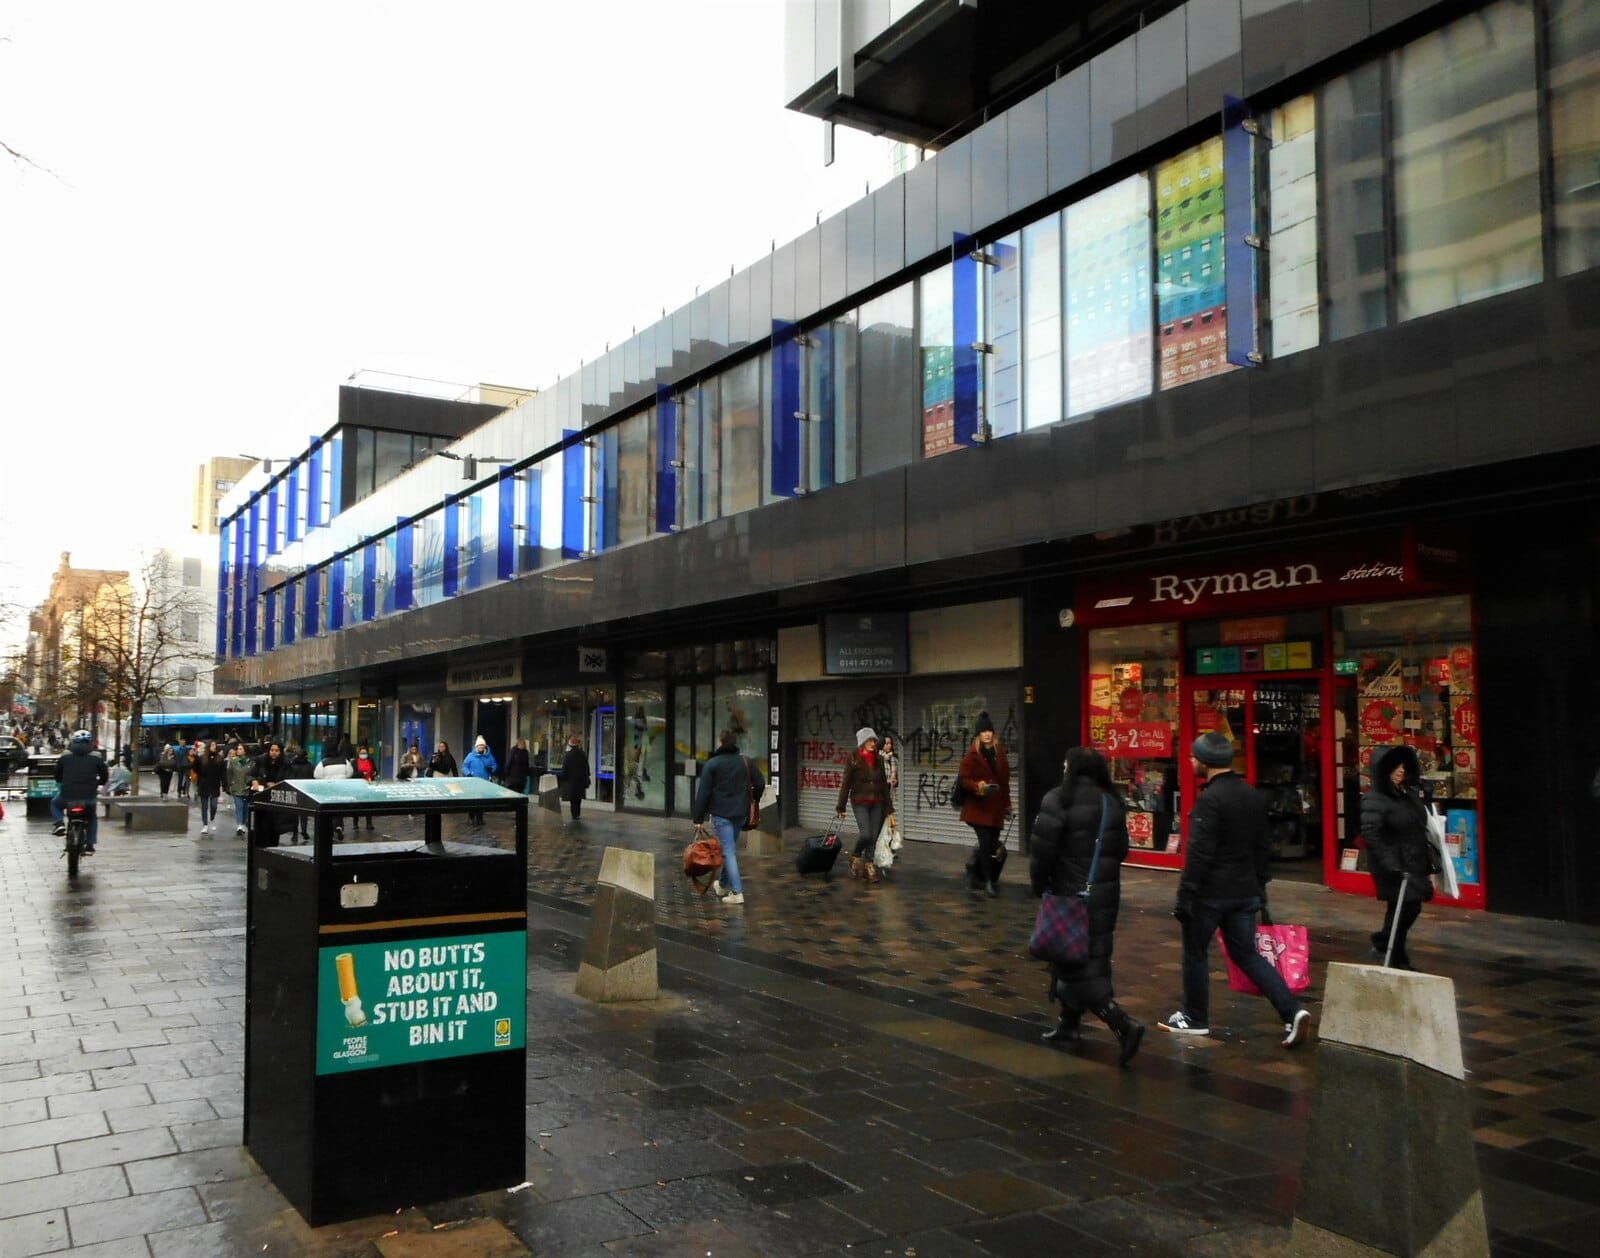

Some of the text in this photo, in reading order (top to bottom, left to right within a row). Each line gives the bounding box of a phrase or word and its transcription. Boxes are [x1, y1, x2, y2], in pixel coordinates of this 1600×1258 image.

[1200, 335, 1217, 345] 10%
[1150, 562, 1323, 605] Ryman
[839, 658, 858, 668] 0141
[1108, 729, 1119, 751] 3
[1128, 728, 1139, 748] 2
[917, 773, 955, 810] RIG
[384, 942, 486, 971] NO BUTTS
[386, 968, 486, 997] ABOUT IT,
[373, 991, 498, 1025] STUB IT AND
[343, 1036, 368, 1046] PEOPLE
[409, 1020, 468, 1046] BIN IT
[332, 1047, 368, 1059] GLASGOW
[347, 1042, 368, 1052] MAKE
